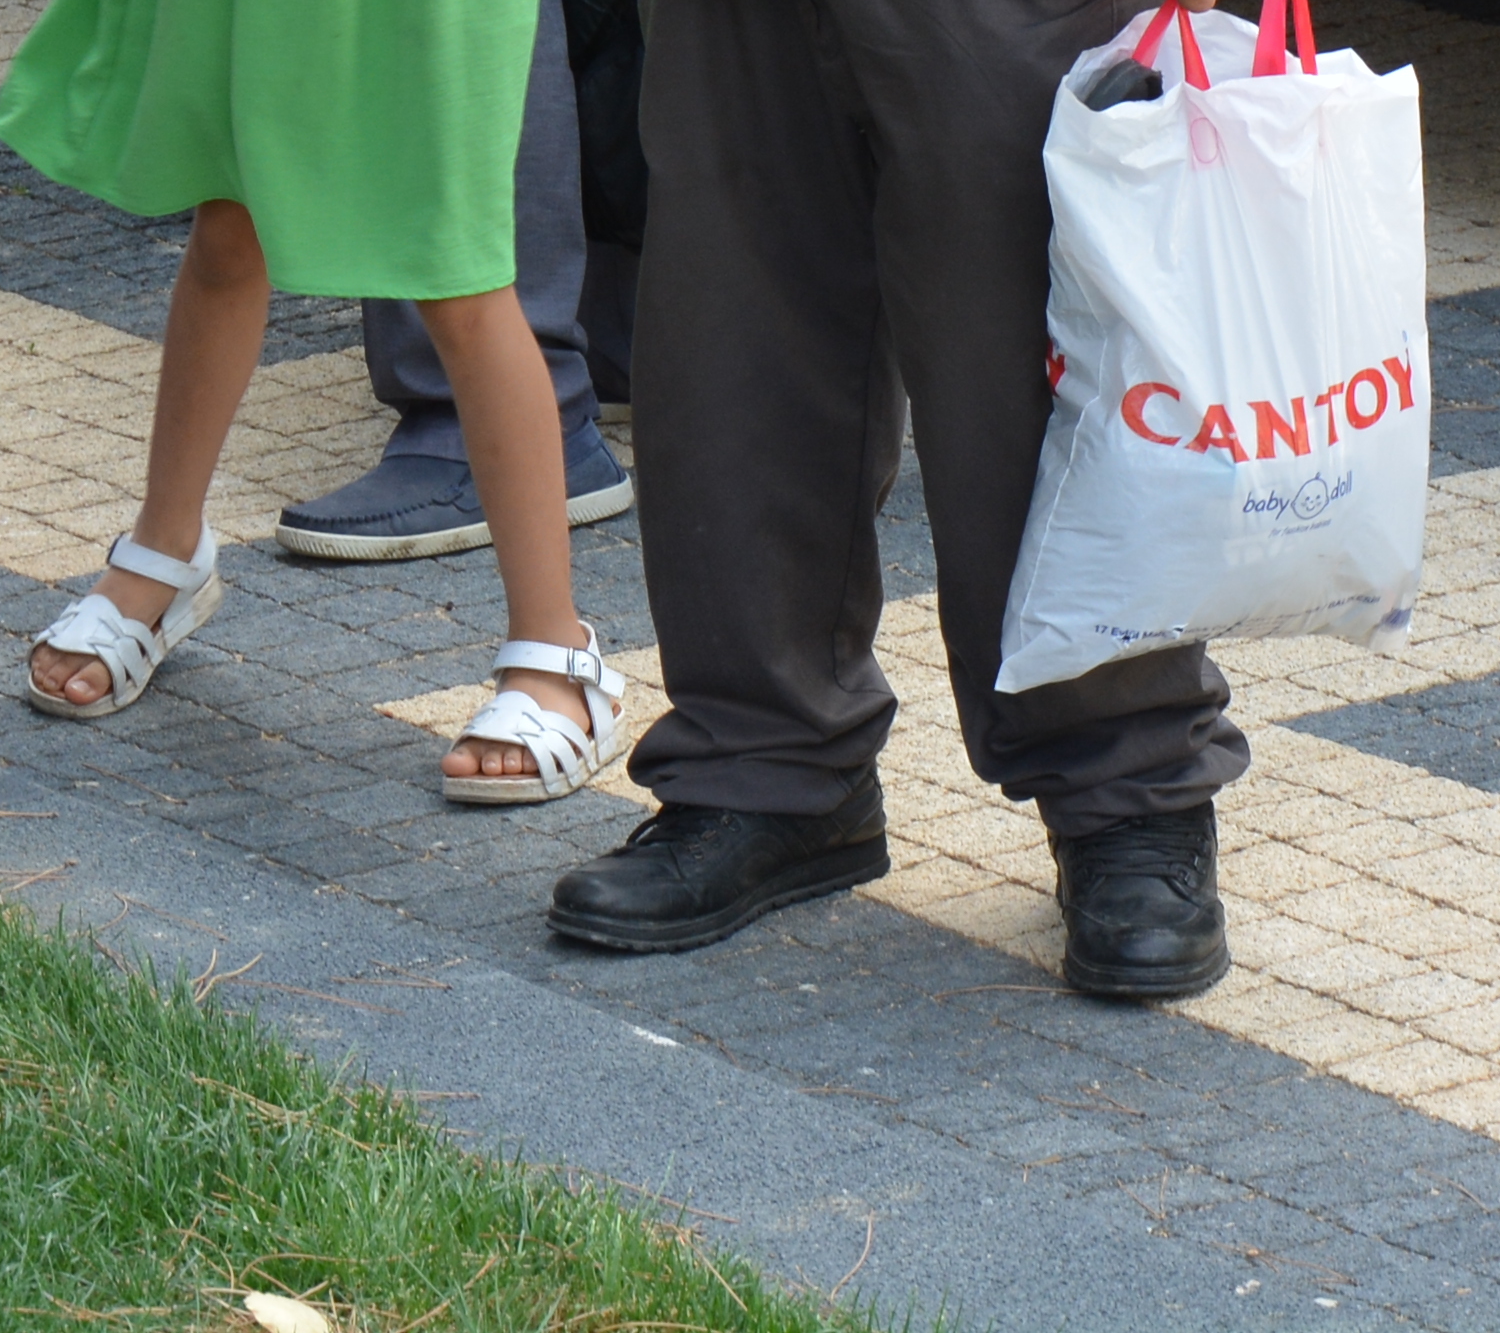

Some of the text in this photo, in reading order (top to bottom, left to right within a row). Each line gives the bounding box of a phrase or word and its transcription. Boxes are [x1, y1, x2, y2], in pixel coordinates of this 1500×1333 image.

[1120, 348, 1415, 464] CANTOY
[1242, 469, 1353, 521] baby doll
